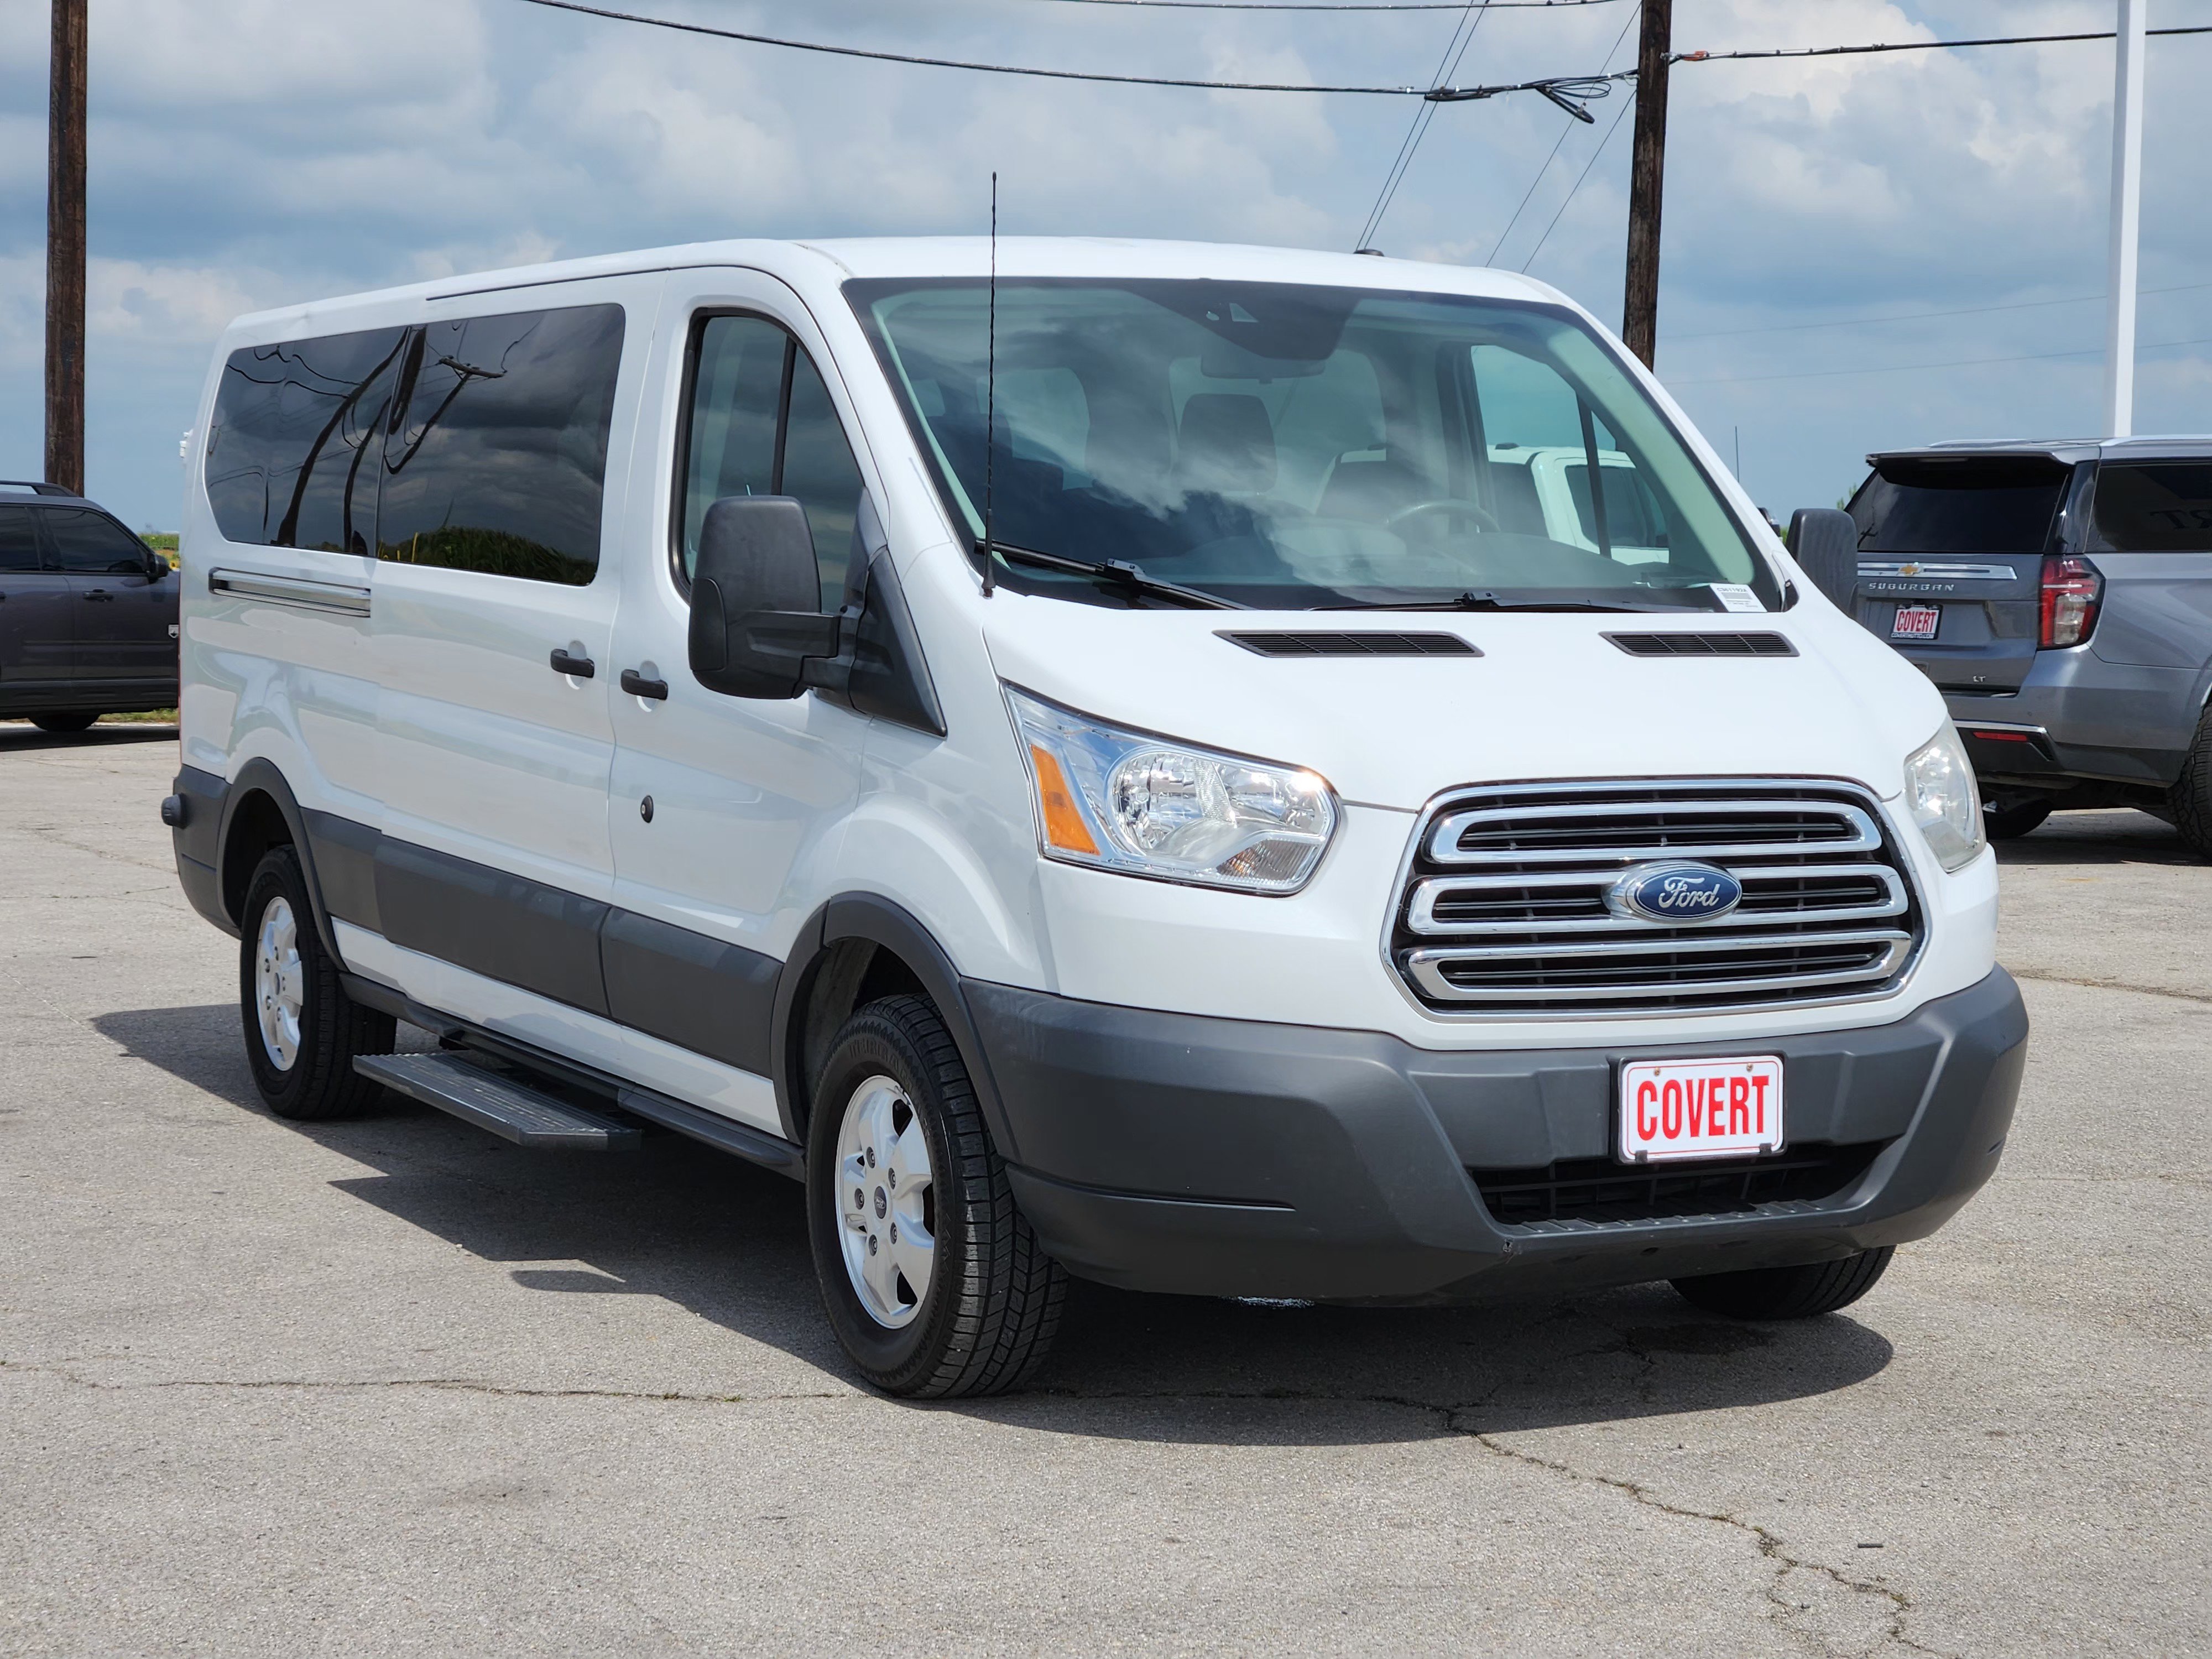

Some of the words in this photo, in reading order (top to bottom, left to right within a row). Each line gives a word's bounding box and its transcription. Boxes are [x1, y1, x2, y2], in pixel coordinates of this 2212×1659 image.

[1869, 582, 1954, 591] SUBURBAN
[1897, 611, 1937, 632] COVERT
[1658, 877, 1720, 907] Ford
[1637, 1076, 1770, 1141] COVERT
